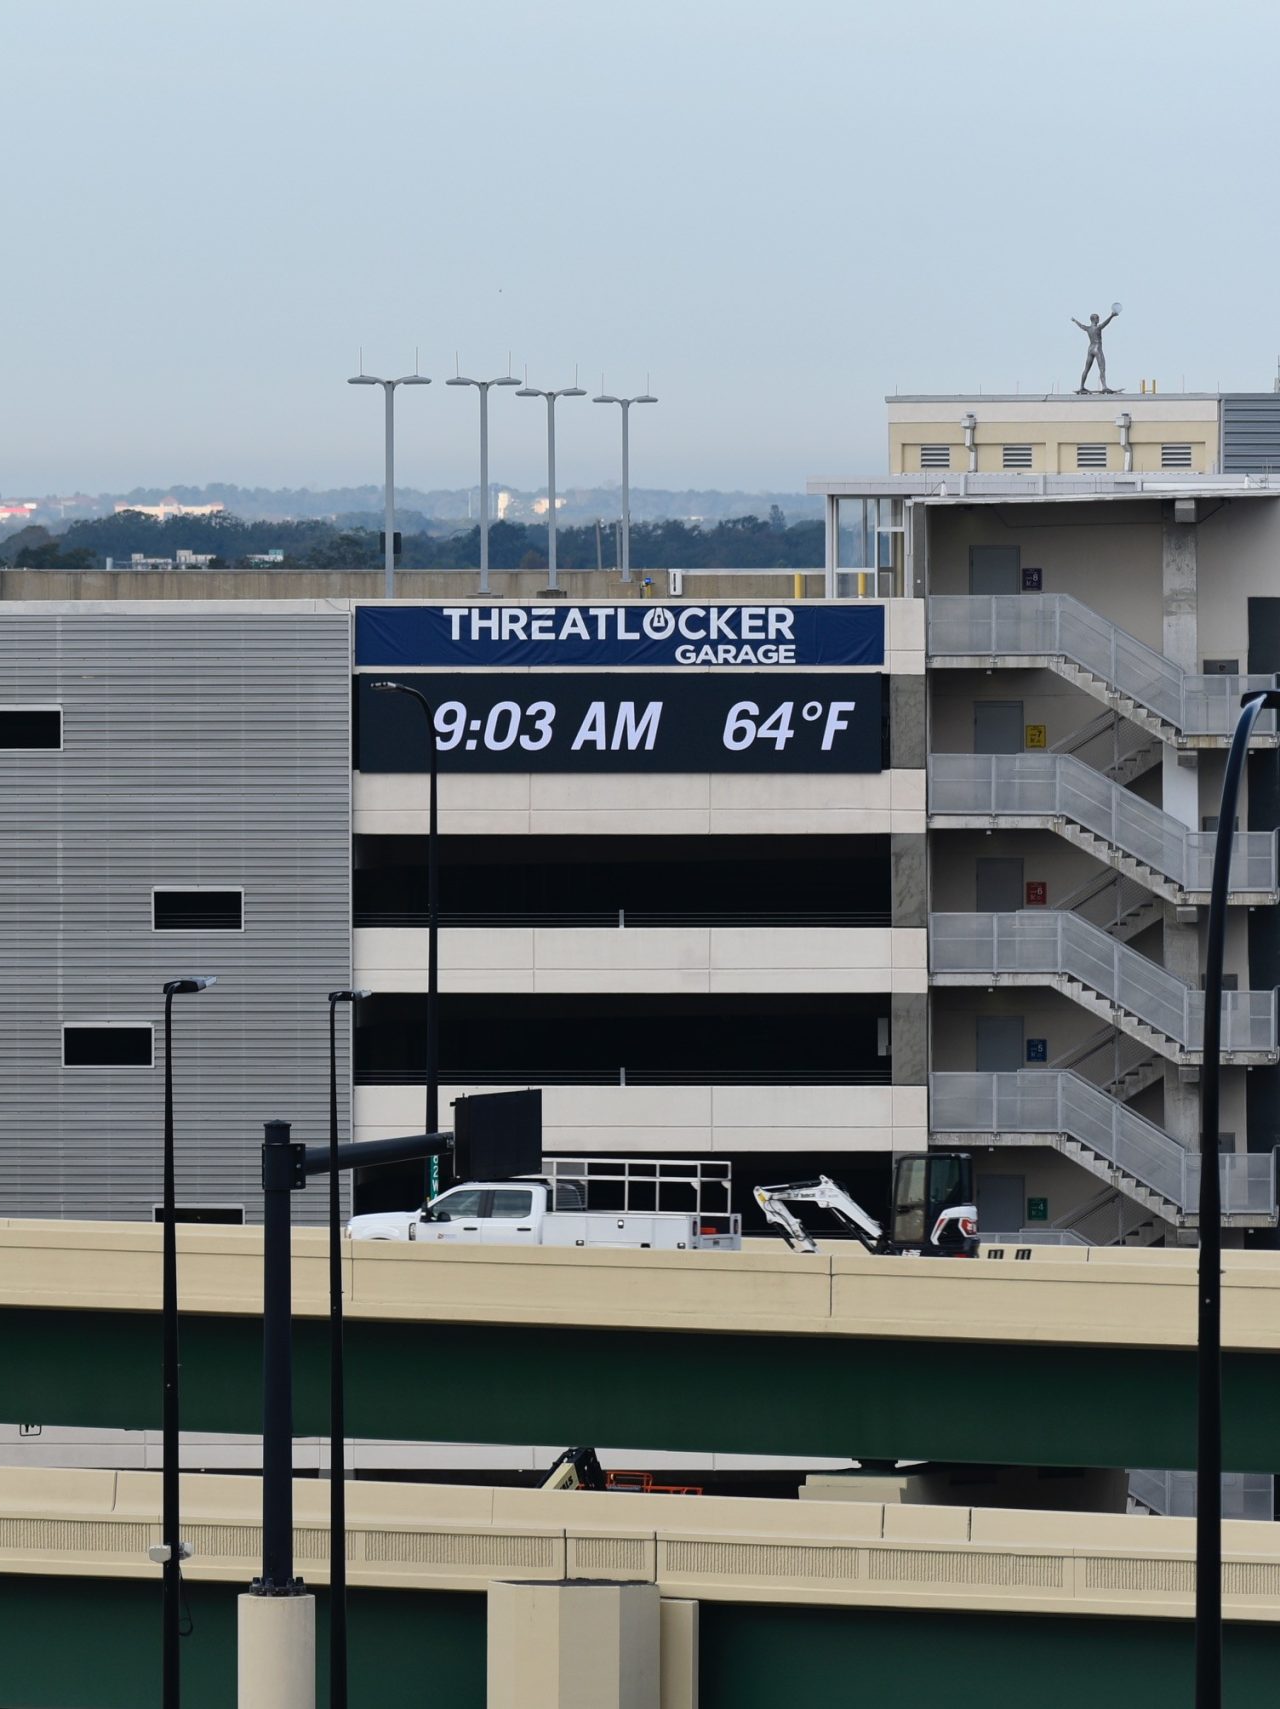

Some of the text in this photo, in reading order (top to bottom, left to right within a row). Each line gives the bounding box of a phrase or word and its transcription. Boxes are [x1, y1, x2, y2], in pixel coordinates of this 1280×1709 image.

[442, 607, 795, 641] THREATLOCKER
[674, 644, 796, 665] GARAGE
[433, 700, 856, 751] 9:03 AM 64°F
